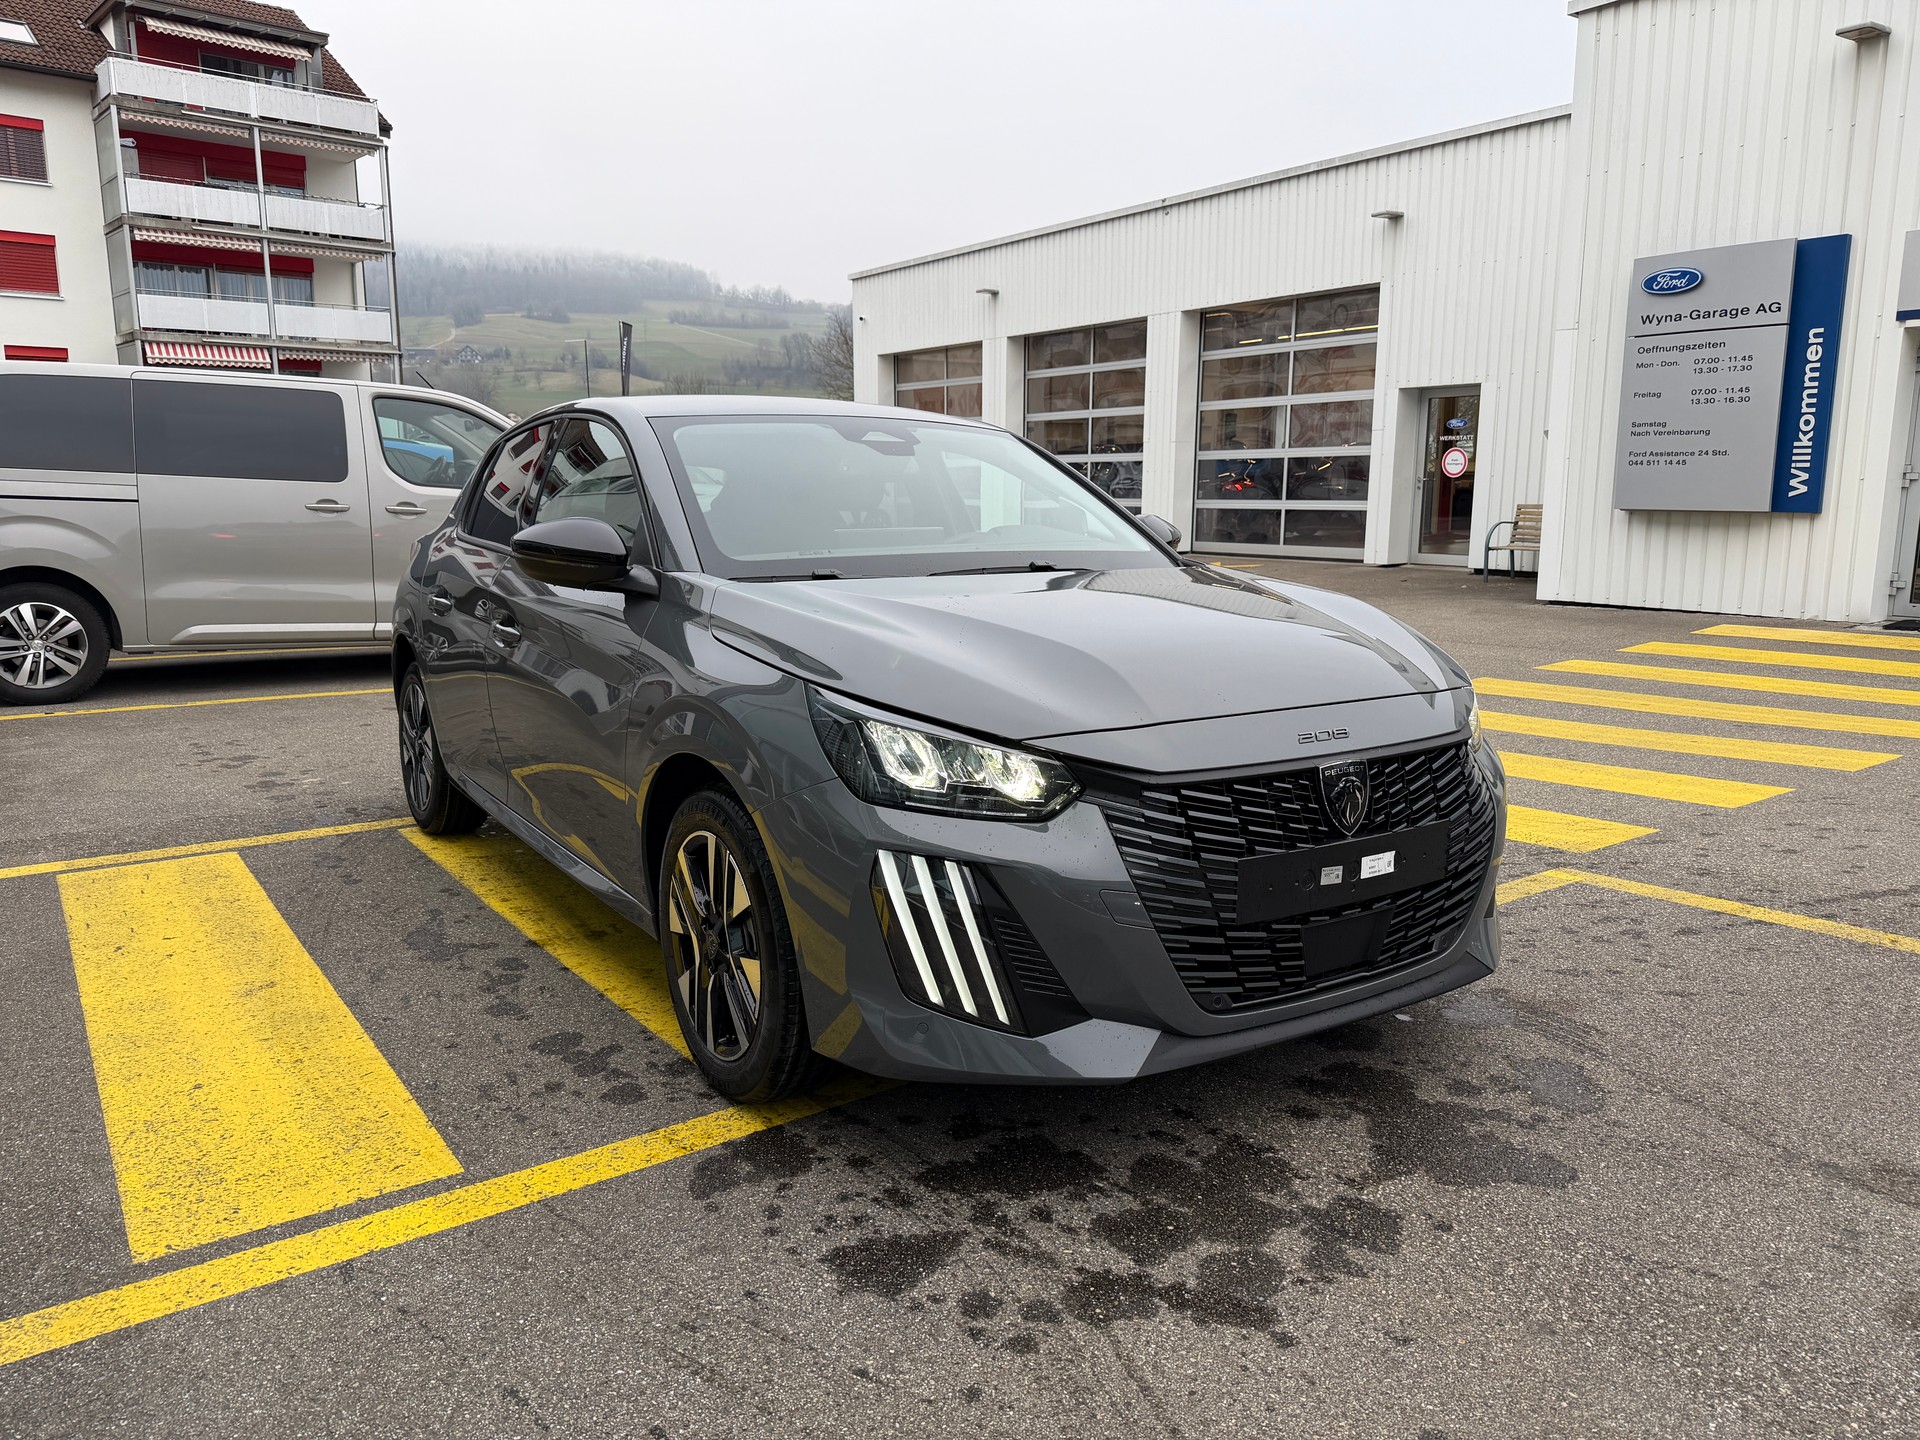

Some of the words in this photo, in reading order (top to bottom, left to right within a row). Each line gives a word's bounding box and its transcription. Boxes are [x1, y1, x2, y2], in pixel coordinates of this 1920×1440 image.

[1652, 271, 1688, 290] Ford
[1640, 304, 1750, 326] Wyna-Garage
[1755, 301, 1782, 314] AG
[1637, 341, 1726, 354] Oeffnungszeiten
[1693, 357, 1720, 365] 07.00
[1693, 366, 1719, 374] 13.30
[1727, 364, 1753, 372] 17.30
[1633, 391, 1661, 399] Freitag
[1725, 386, 1750, 394] 11.45
[1788, 327, 1825, 497] Willkommen
[1297, 727, 1350, 744] 208
[1324, 765, 1365, 777] PEUGEOT
